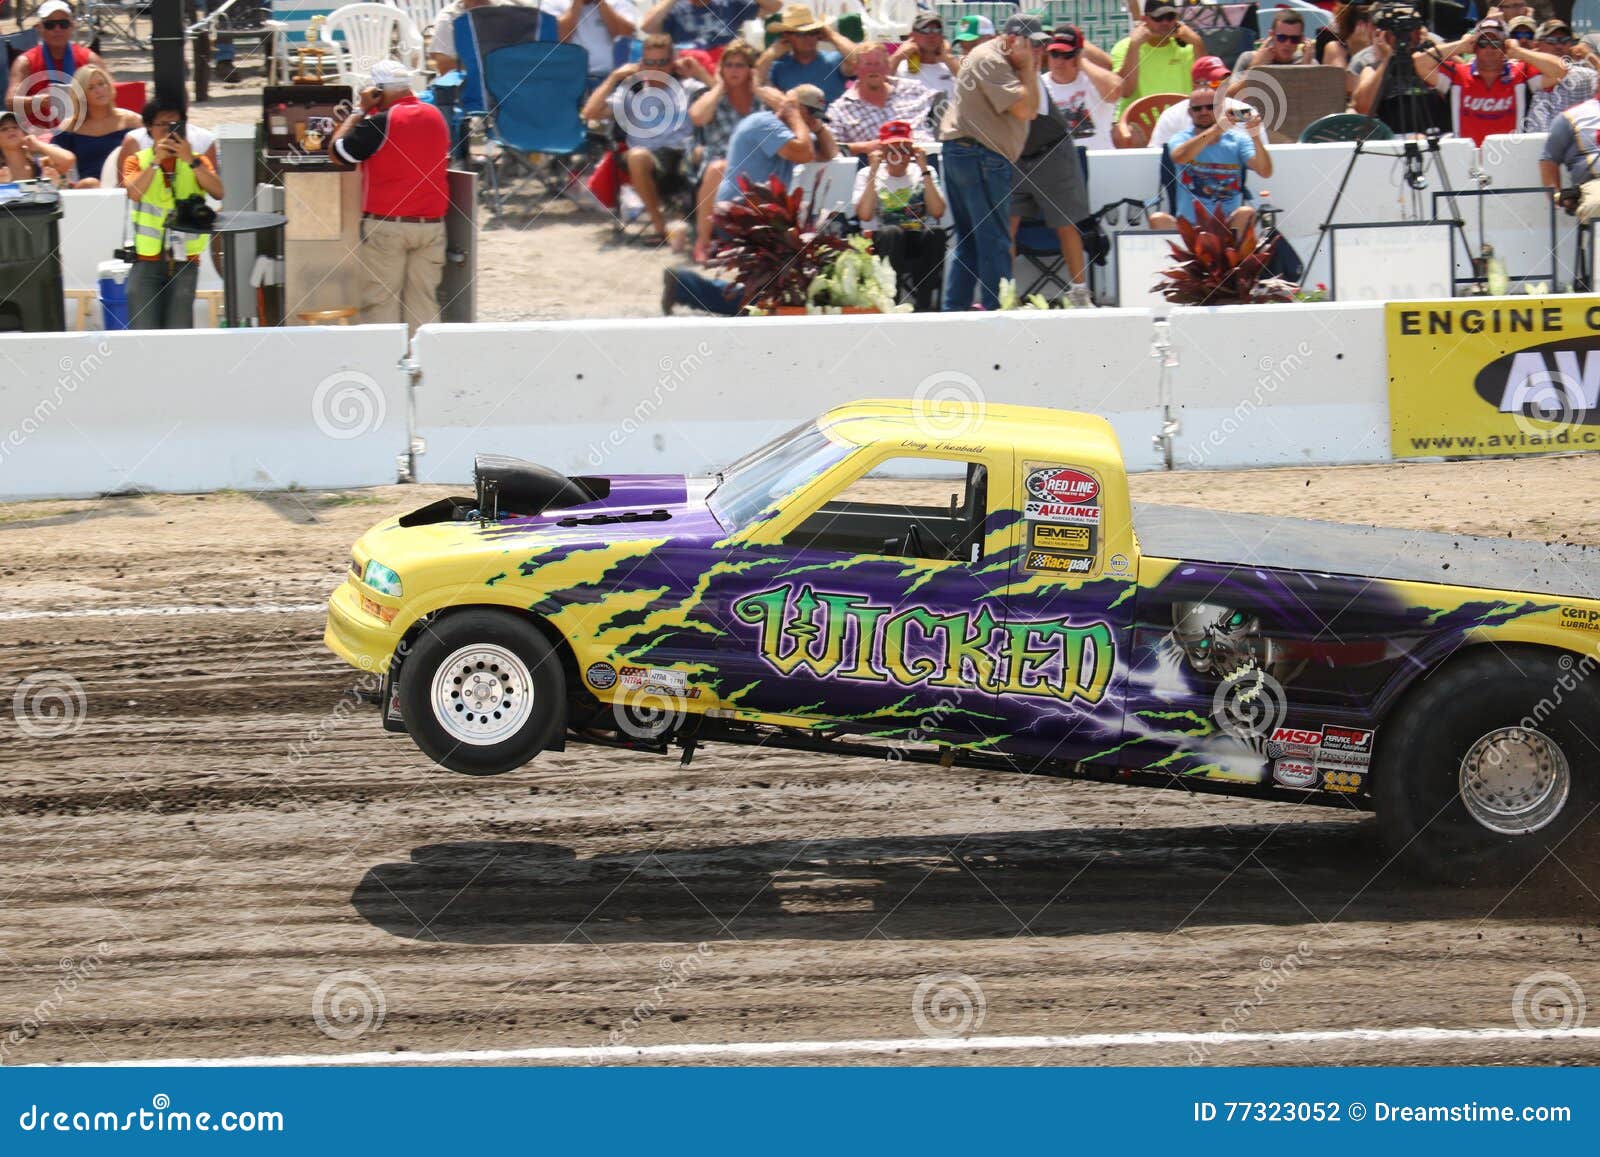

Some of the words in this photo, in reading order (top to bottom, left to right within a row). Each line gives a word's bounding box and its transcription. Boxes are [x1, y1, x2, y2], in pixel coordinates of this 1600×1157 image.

[1464, 96, 1514, 111] LUCAS
[1400, 307, 1563, 335] ENGINE
[1411, 430, 1600, 450] www.aviaid.c
[1048, 479, 1068, 491] RED
[1070, 481, 1094, 493] LINE
[1038, 504, 1099, 517] ALLIANCE
[1043, 555, 1091, 572] Racepak
[734, 583, 1117, 705] WICKED
[1272, 729, 1322, 744] MSD
